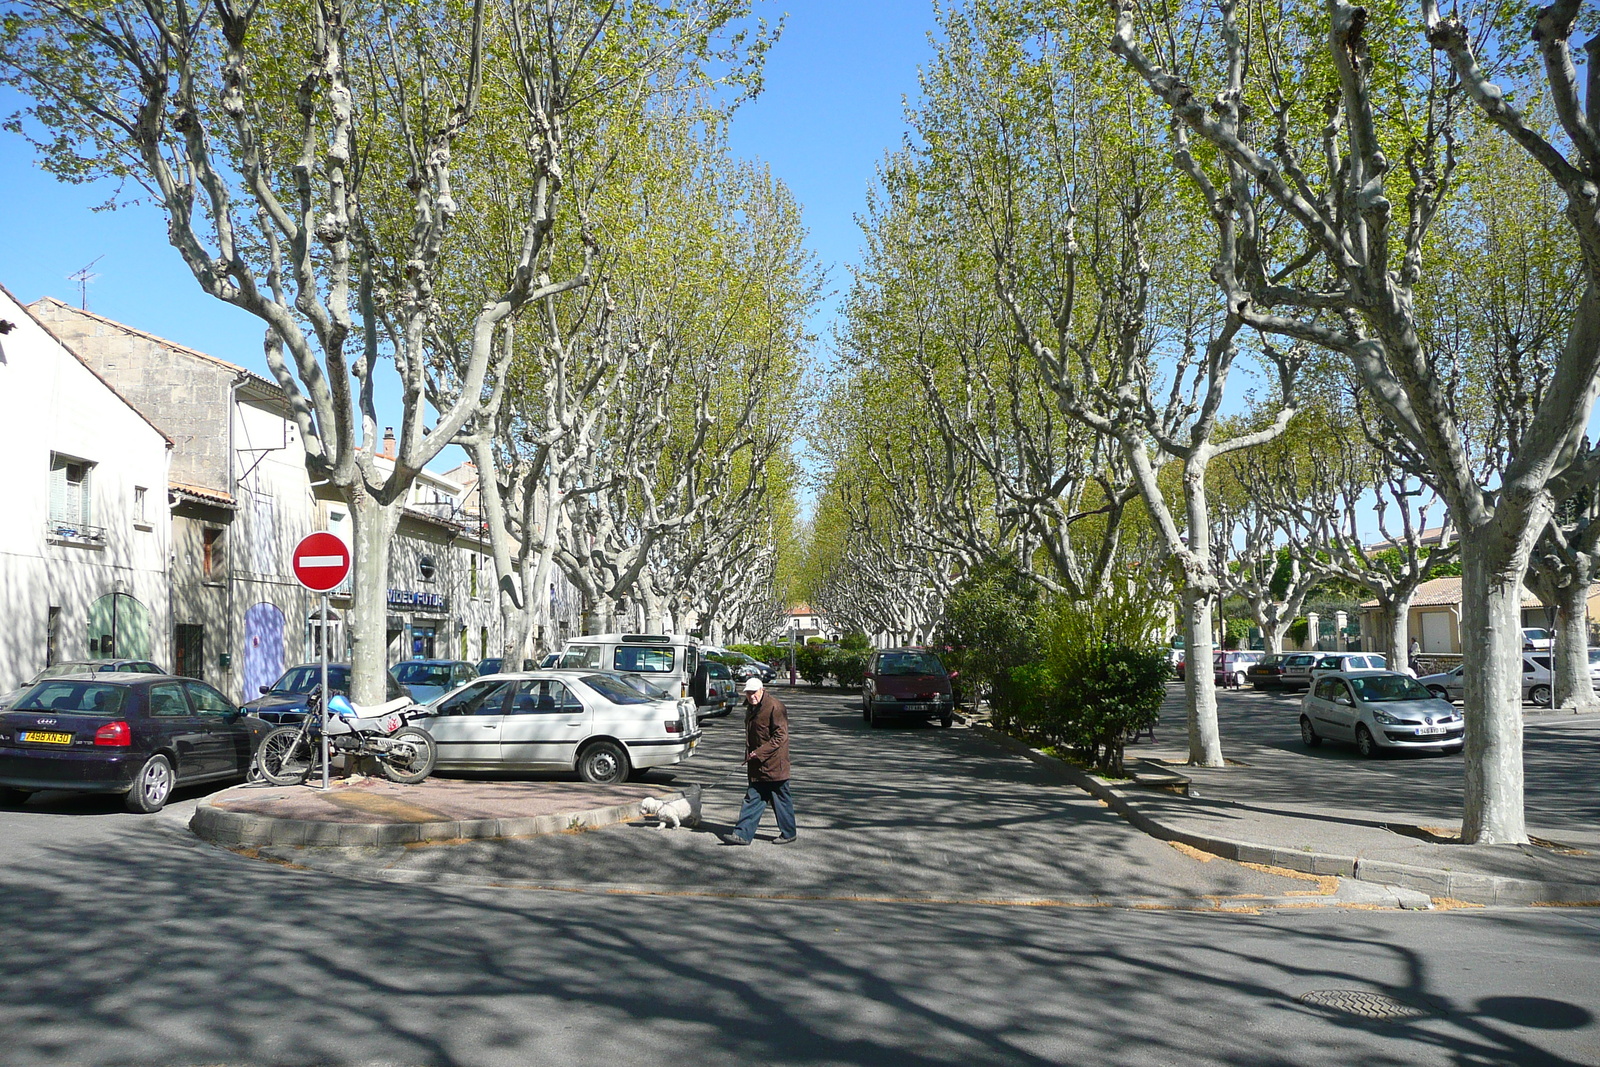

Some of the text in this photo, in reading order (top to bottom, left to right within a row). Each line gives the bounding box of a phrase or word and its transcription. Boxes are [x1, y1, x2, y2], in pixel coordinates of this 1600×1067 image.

[387, 589, 444, 606] VIDEO FUTUR
[26, 731, 45, 741] 7498
[46, 732, 57, 742] XN
[58, 733, 69, 743] 30
